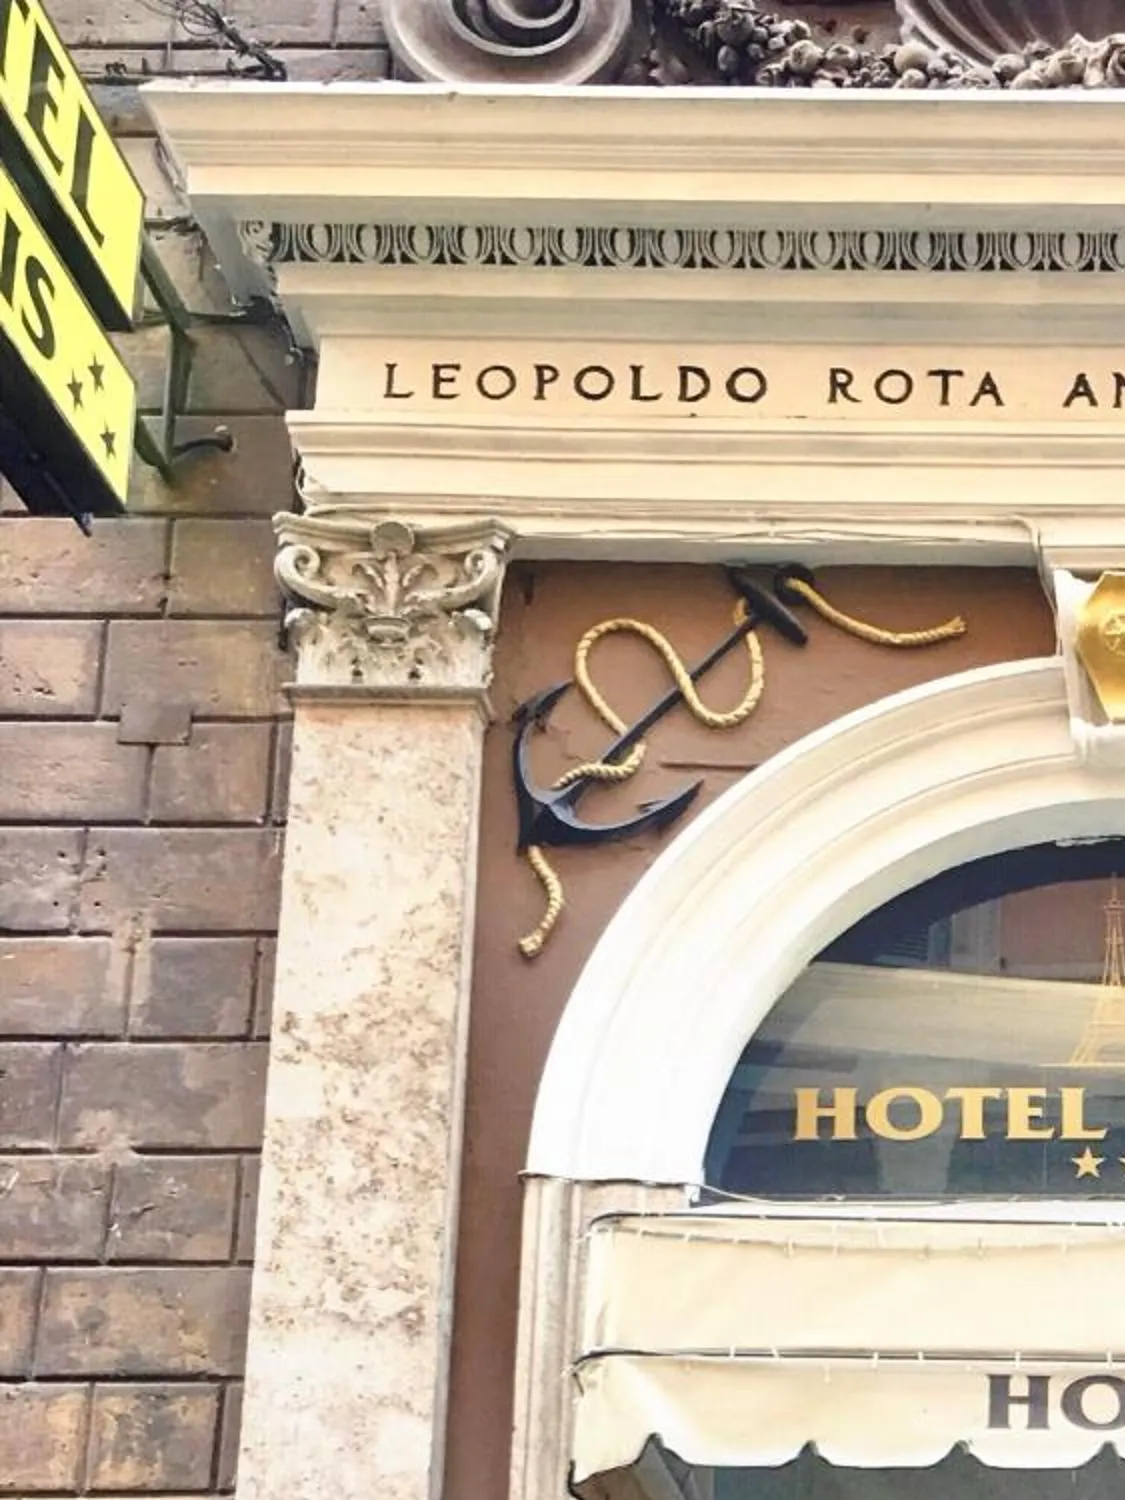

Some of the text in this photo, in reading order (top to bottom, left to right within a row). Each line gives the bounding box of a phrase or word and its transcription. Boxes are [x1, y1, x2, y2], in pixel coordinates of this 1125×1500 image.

[383, 363, 768, 403] LEOPOLDO
[827, 366, 1005, 407] ROTA
[793, 1086, 1107, 1142] HOTEL
